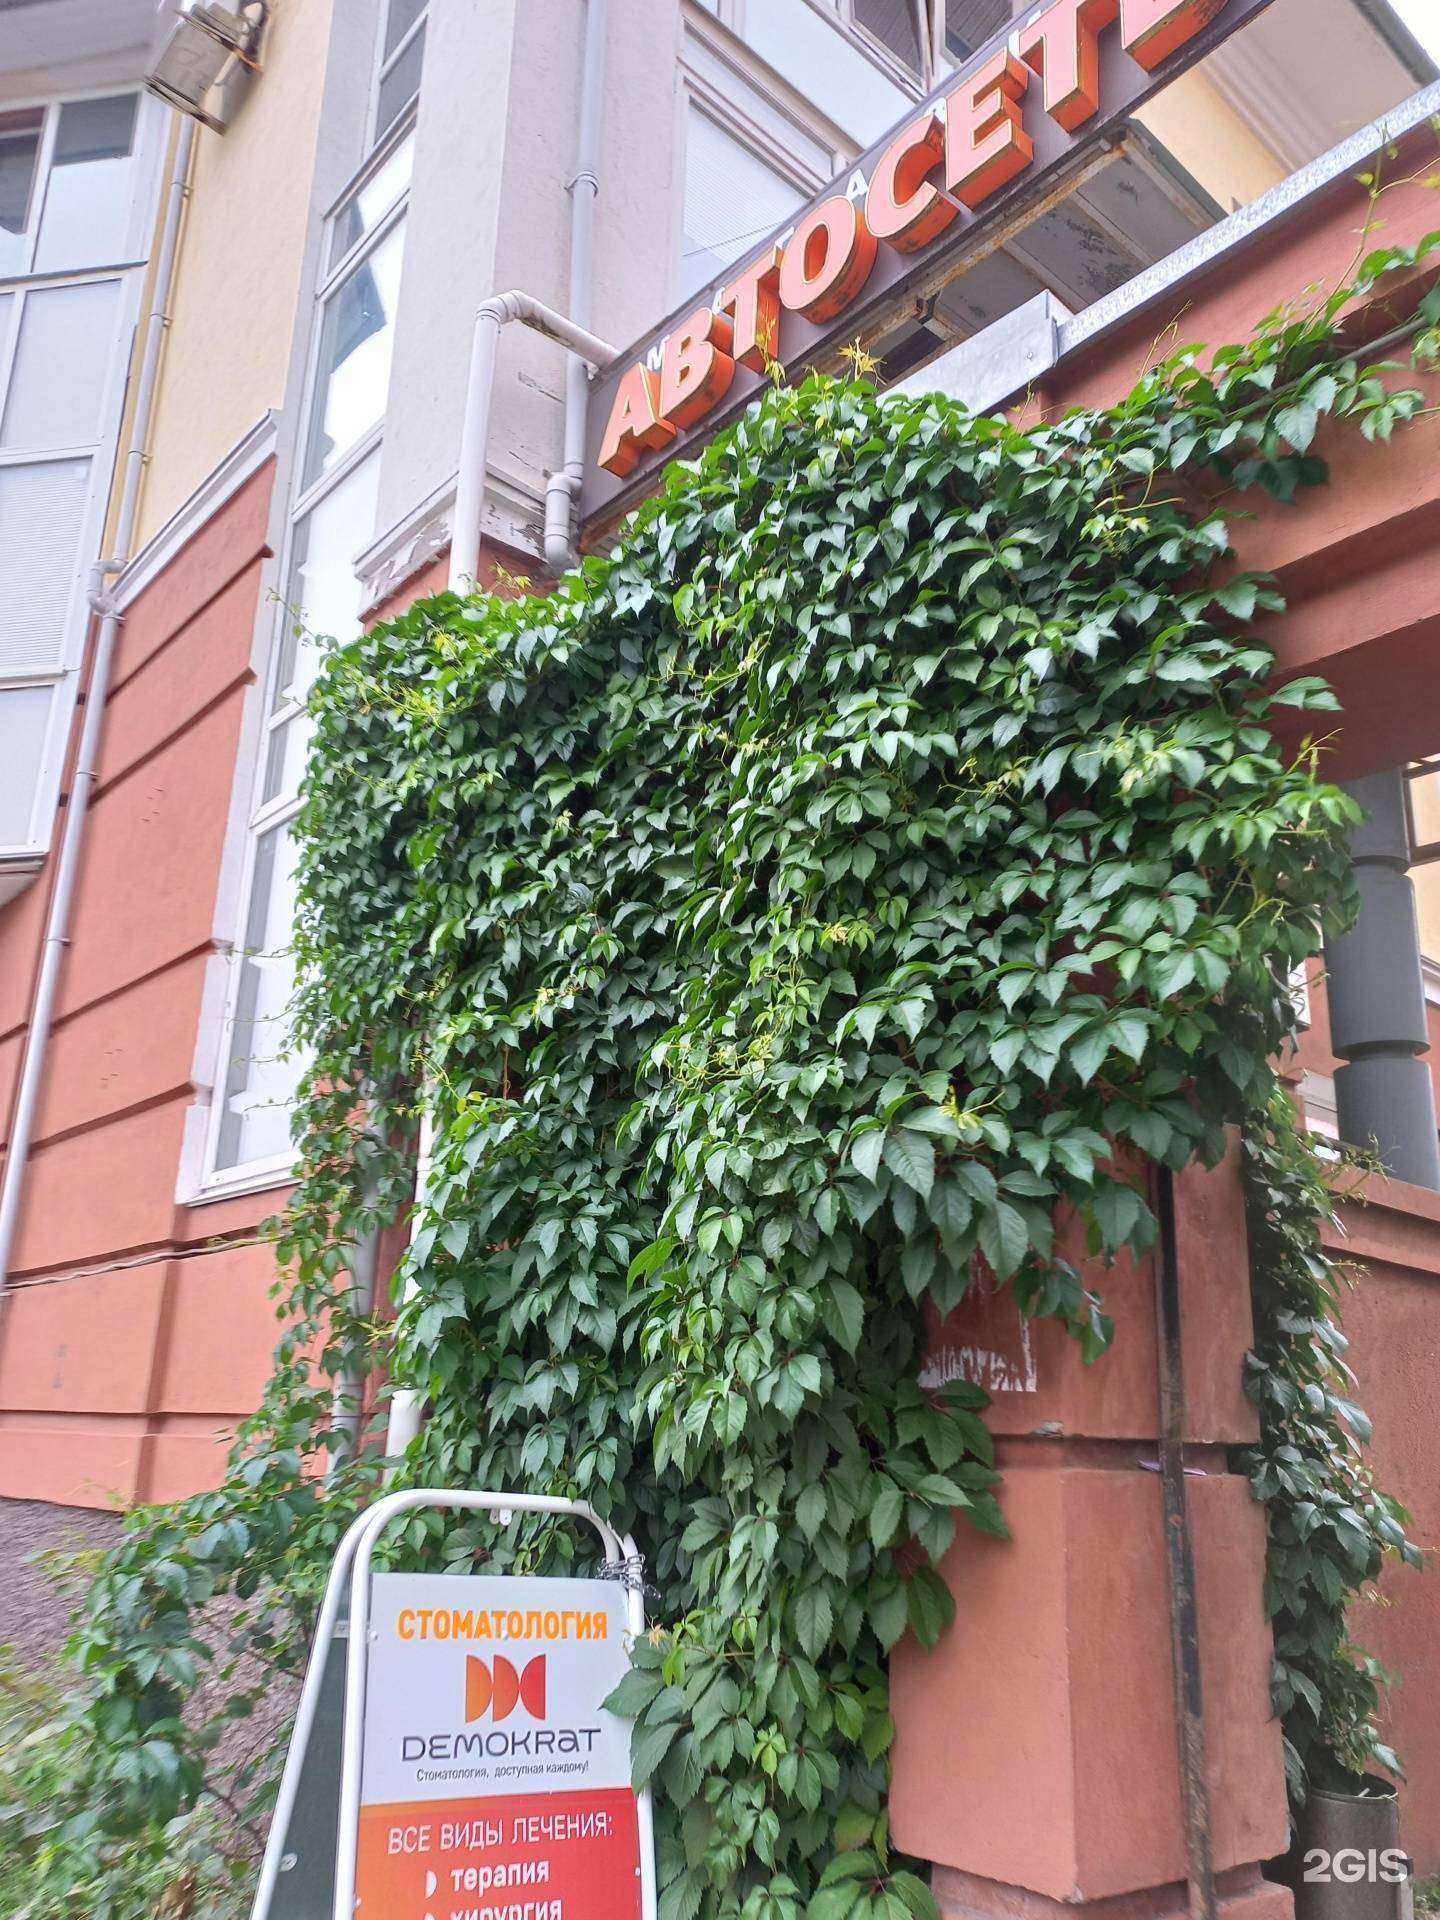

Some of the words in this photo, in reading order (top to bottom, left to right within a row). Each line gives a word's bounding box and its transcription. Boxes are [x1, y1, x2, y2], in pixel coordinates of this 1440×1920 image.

[398, 1609, 607, 1640] СТОМАТОЛОГИЯ
[416, 1766, 489, 1782] Стоматология,
[494, 1762, 544, 1779] доступная
[546, 1760, 589, 1775] каждому!
[388, 1825, 431, 1854] ВСЕ
[440, 1820, 503, 1851] ВИДЫ
[511, 1811, 613, 1843] ЛЕЧЕНИЯ:
[451, 1860, 549, 1897] терапия
